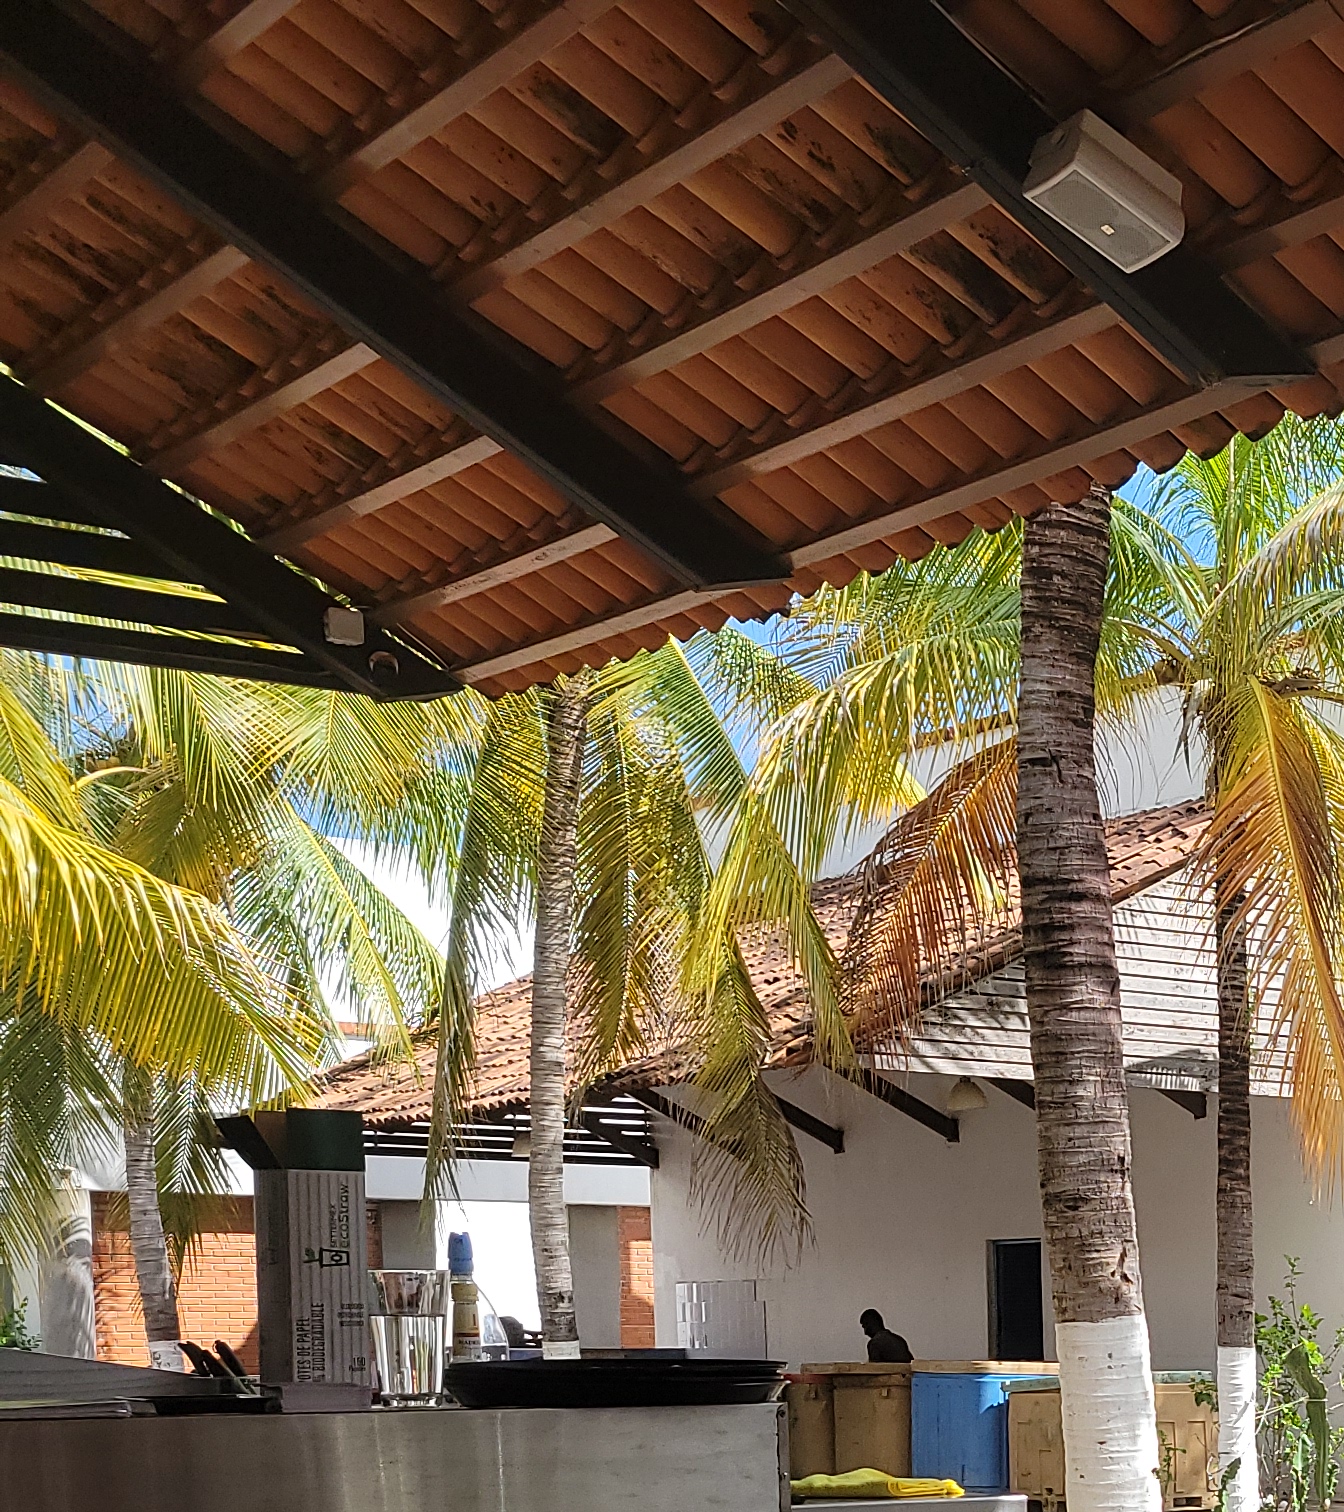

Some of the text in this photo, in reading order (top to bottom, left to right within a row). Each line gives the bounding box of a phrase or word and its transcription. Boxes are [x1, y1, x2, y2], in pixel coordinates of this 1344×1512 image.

[295, 1317, 311, 1383] OTES DE PAPEL
[311, 1302, 325, 1371] BIODEGRADABLE
